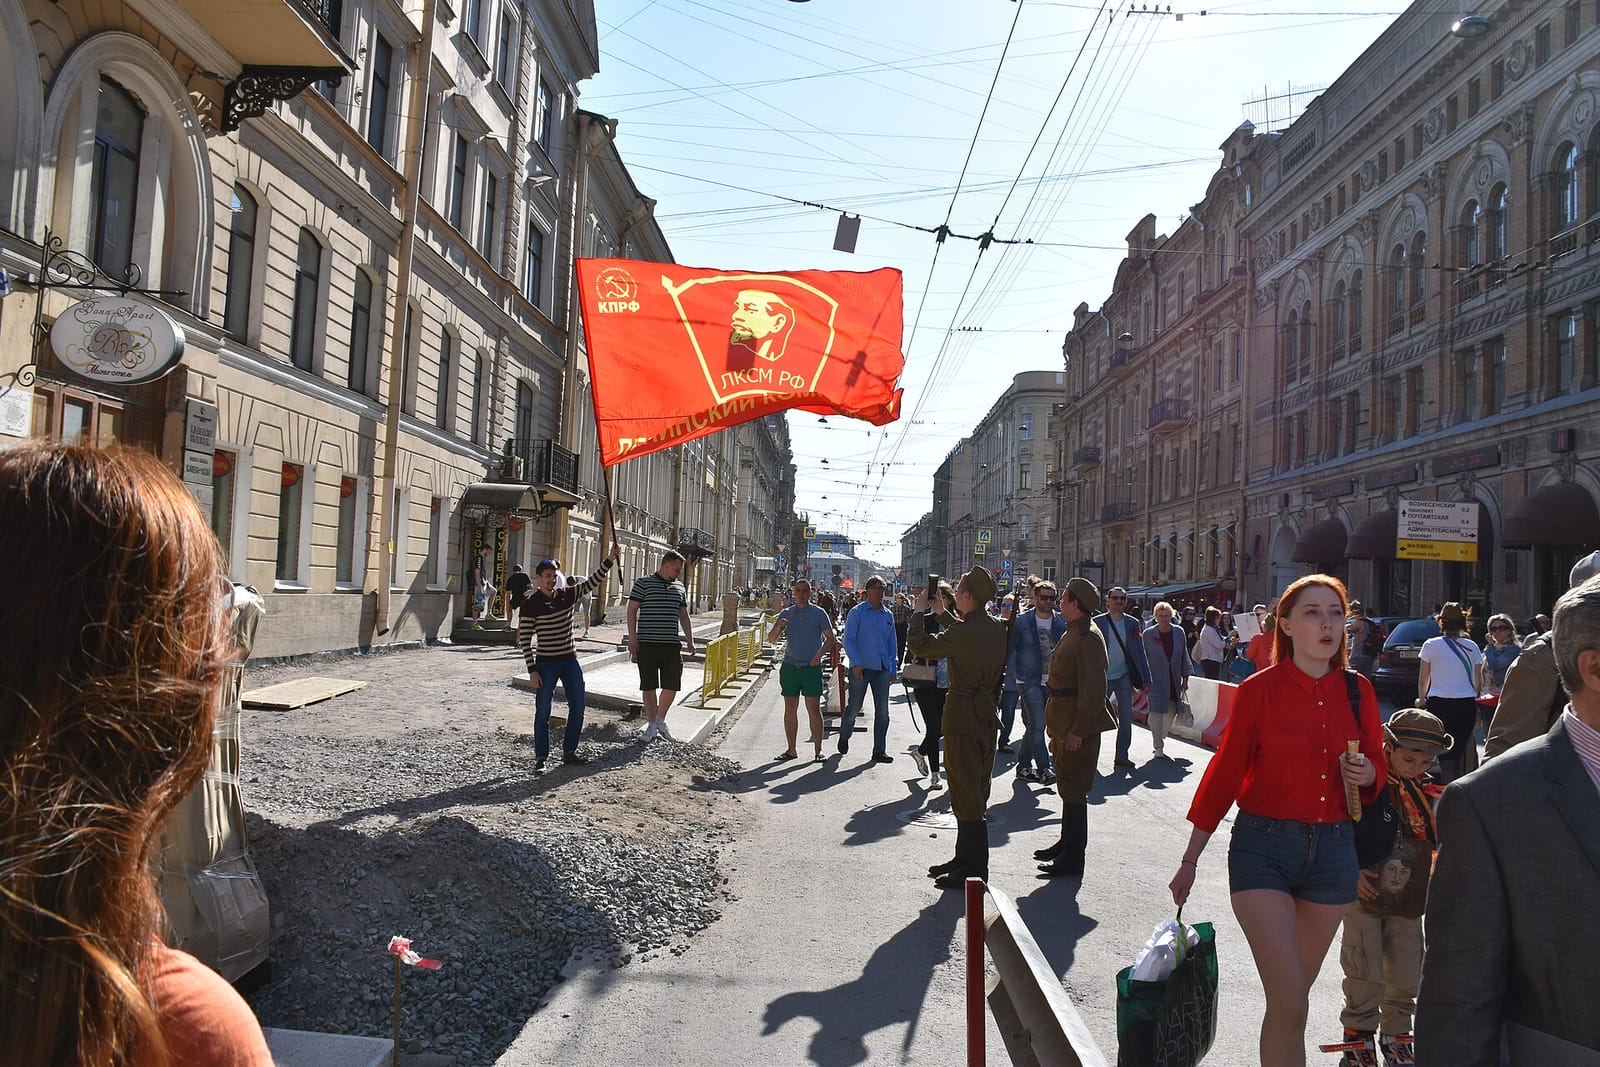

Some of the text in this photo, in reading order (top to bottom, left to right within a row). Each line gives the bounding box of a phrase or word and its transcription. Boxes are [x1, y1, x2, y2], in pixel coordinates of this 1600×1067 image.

[598, 300, 641, 314] КПРФ
[720, 367, 805, 390] ЛКСМ РФ
[1407, 526, 1461, 534] АДМИРАЛТЕЙСКИЙ
[492, 531, 505, 615] СУВЕНИРЫ
